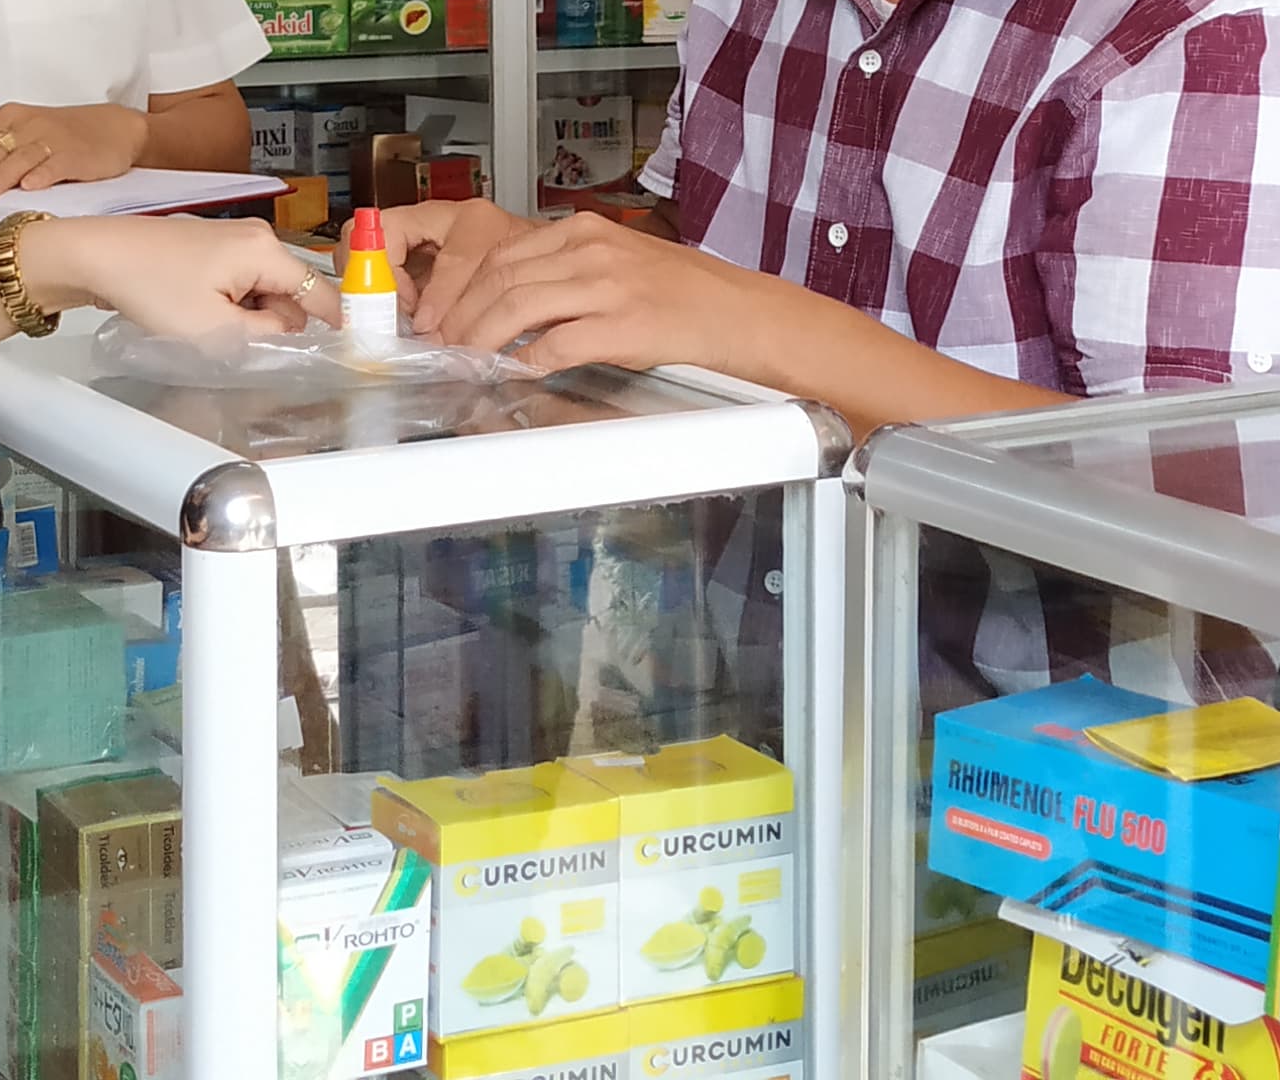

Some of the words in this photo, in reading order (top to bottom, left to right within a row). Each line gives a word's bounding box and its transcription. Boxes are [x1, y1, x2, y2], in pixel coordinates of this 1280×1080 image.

[251, 123, 286, 146] nxi
[948, 759, 1066, 825] RHUMENOL
[1073, 796, 1114, 838] FLU
[1120, 812, 1167, 856] 500
[634, 822, 783, 868] CURCUMIN
[453, 849, 607, 897] CURCUMIN
[344, 922, 416, 949] ROHTO
[401, 1003, 417, 1027] P
[372, 1039, 389, 1063] B
[399, 1032, 418, 1058] A
[643, 1028, 792, 1078] CURCUMIN
[1100, 1024, 1170, 1074] FORTE
